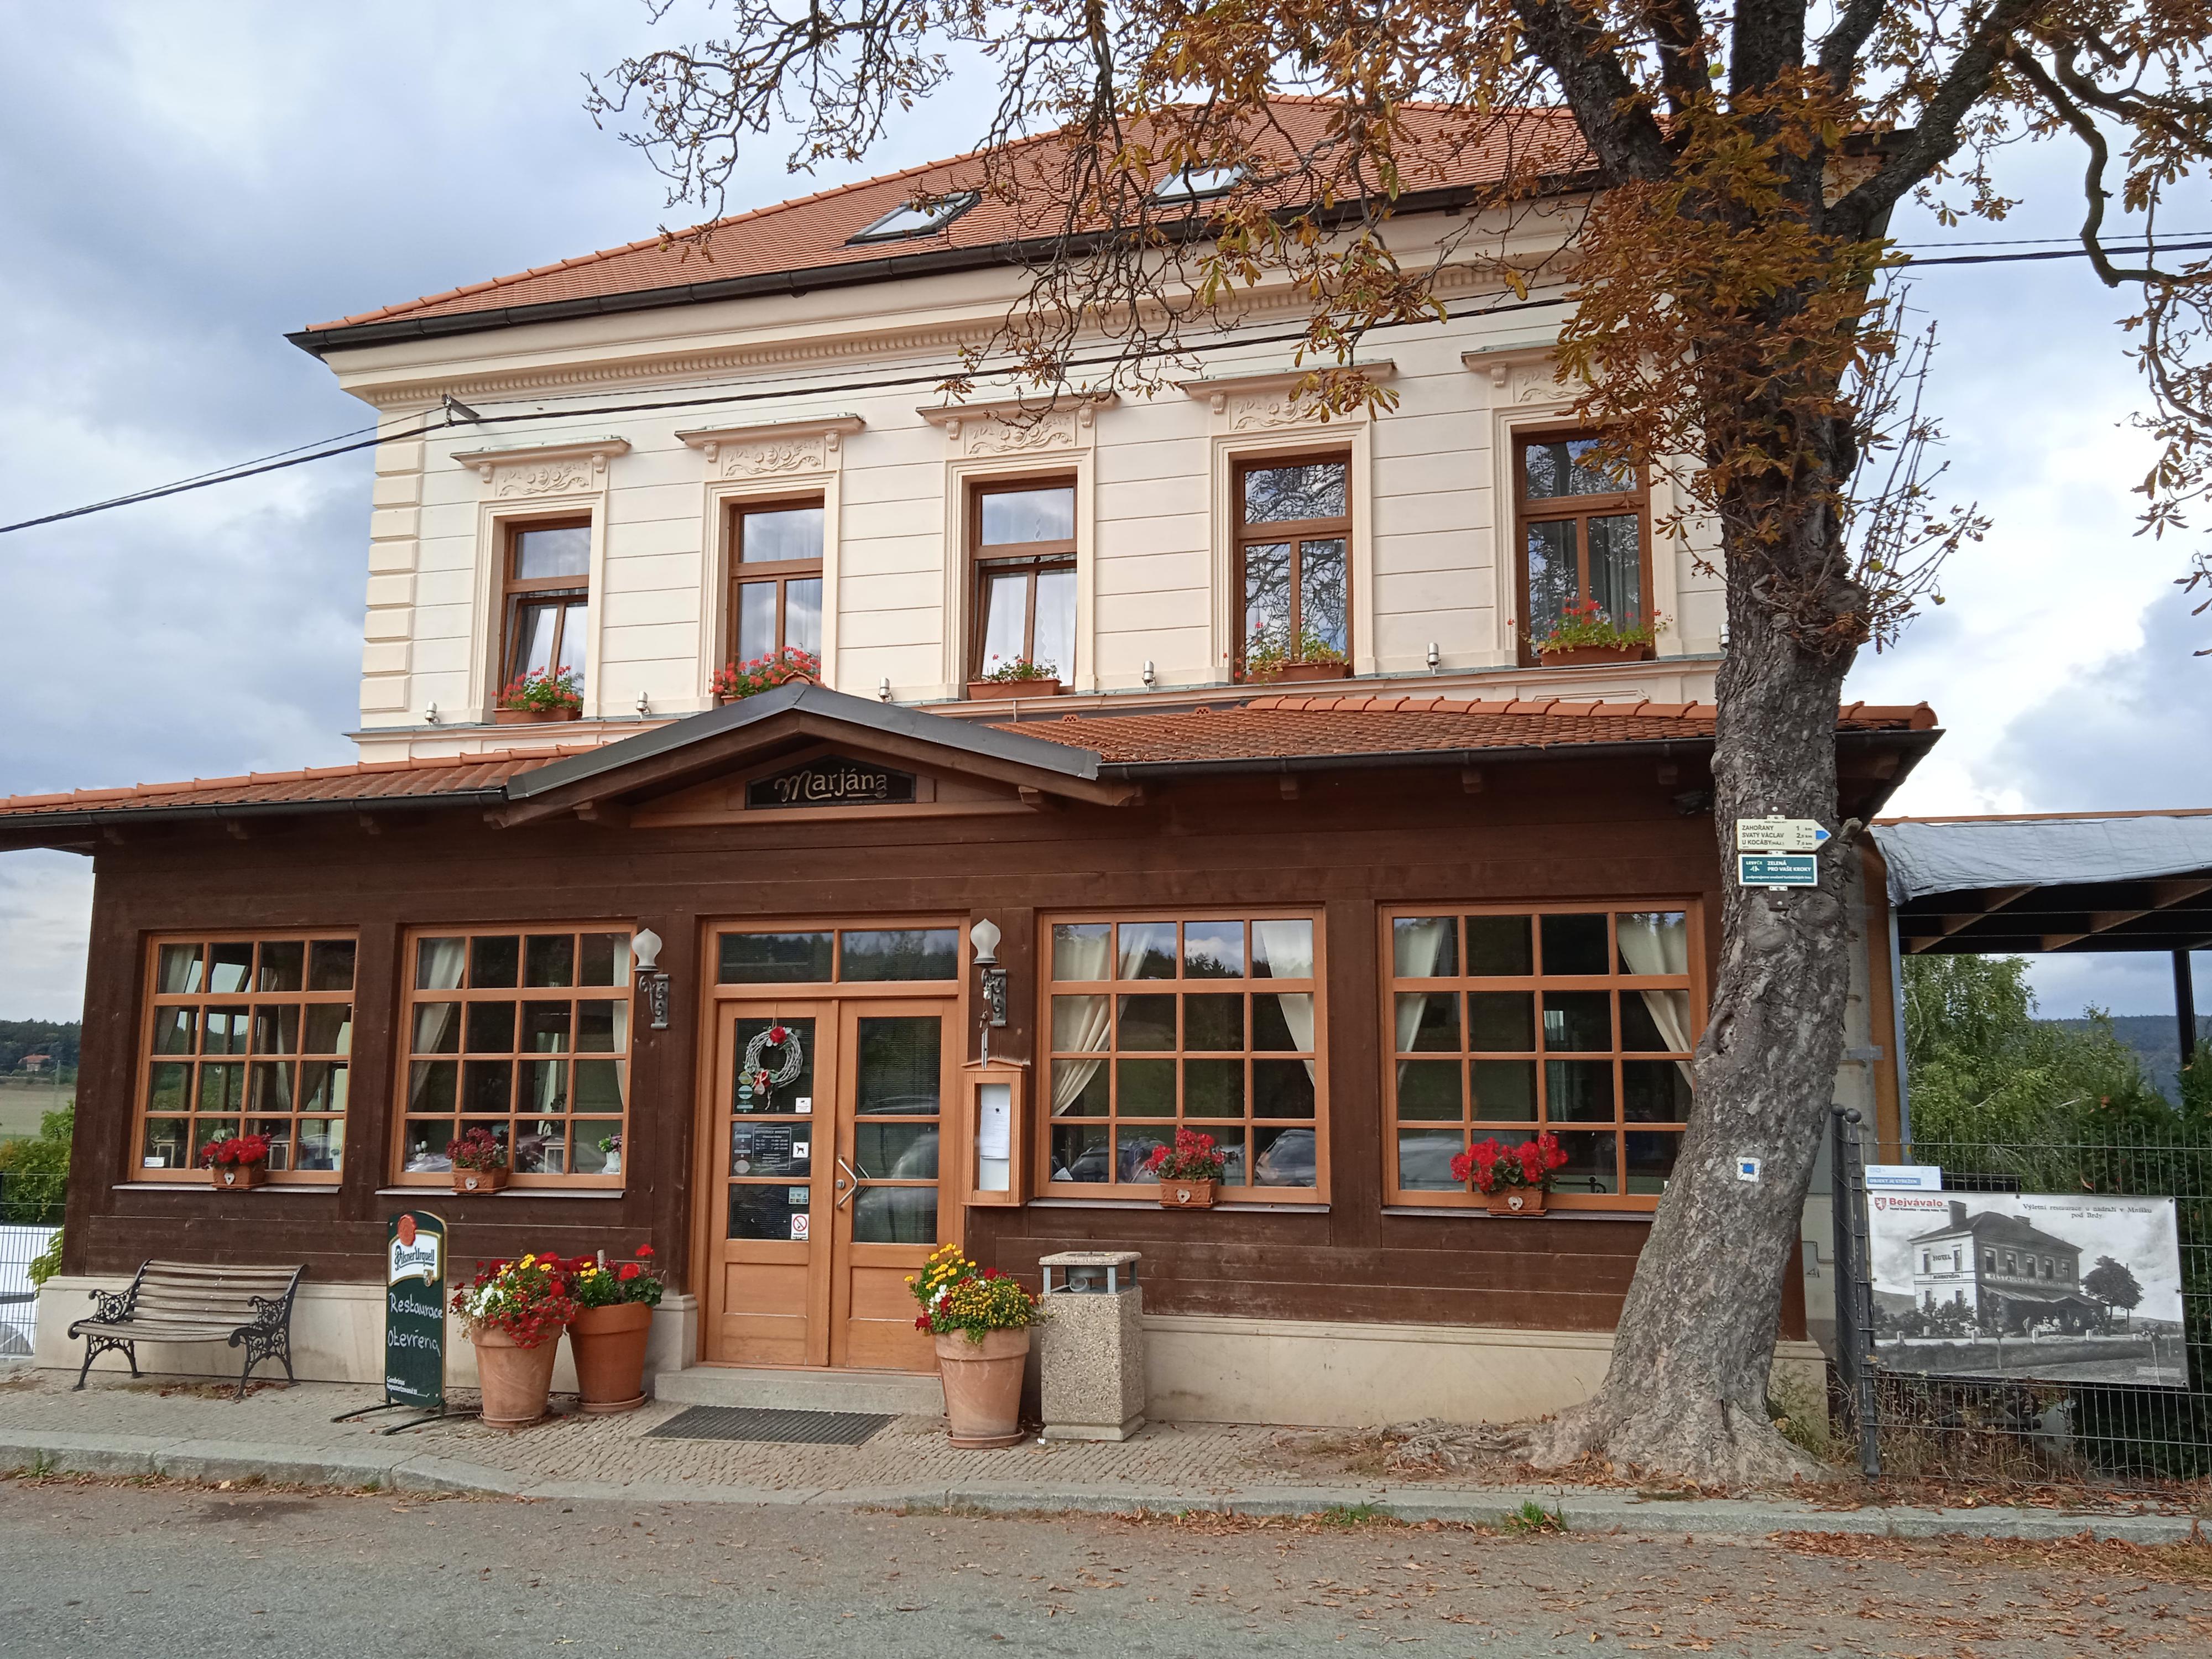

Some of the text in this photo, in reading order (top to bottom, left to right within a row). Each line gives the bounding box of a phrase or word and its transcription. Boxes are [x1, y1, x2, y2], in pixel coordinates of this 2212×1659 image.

[775, 768, 887, 802] Marjána
[395, 1245, 435, 1271] Pilsner Urquell
[389, 1292, 443, 1319] Restaurace
